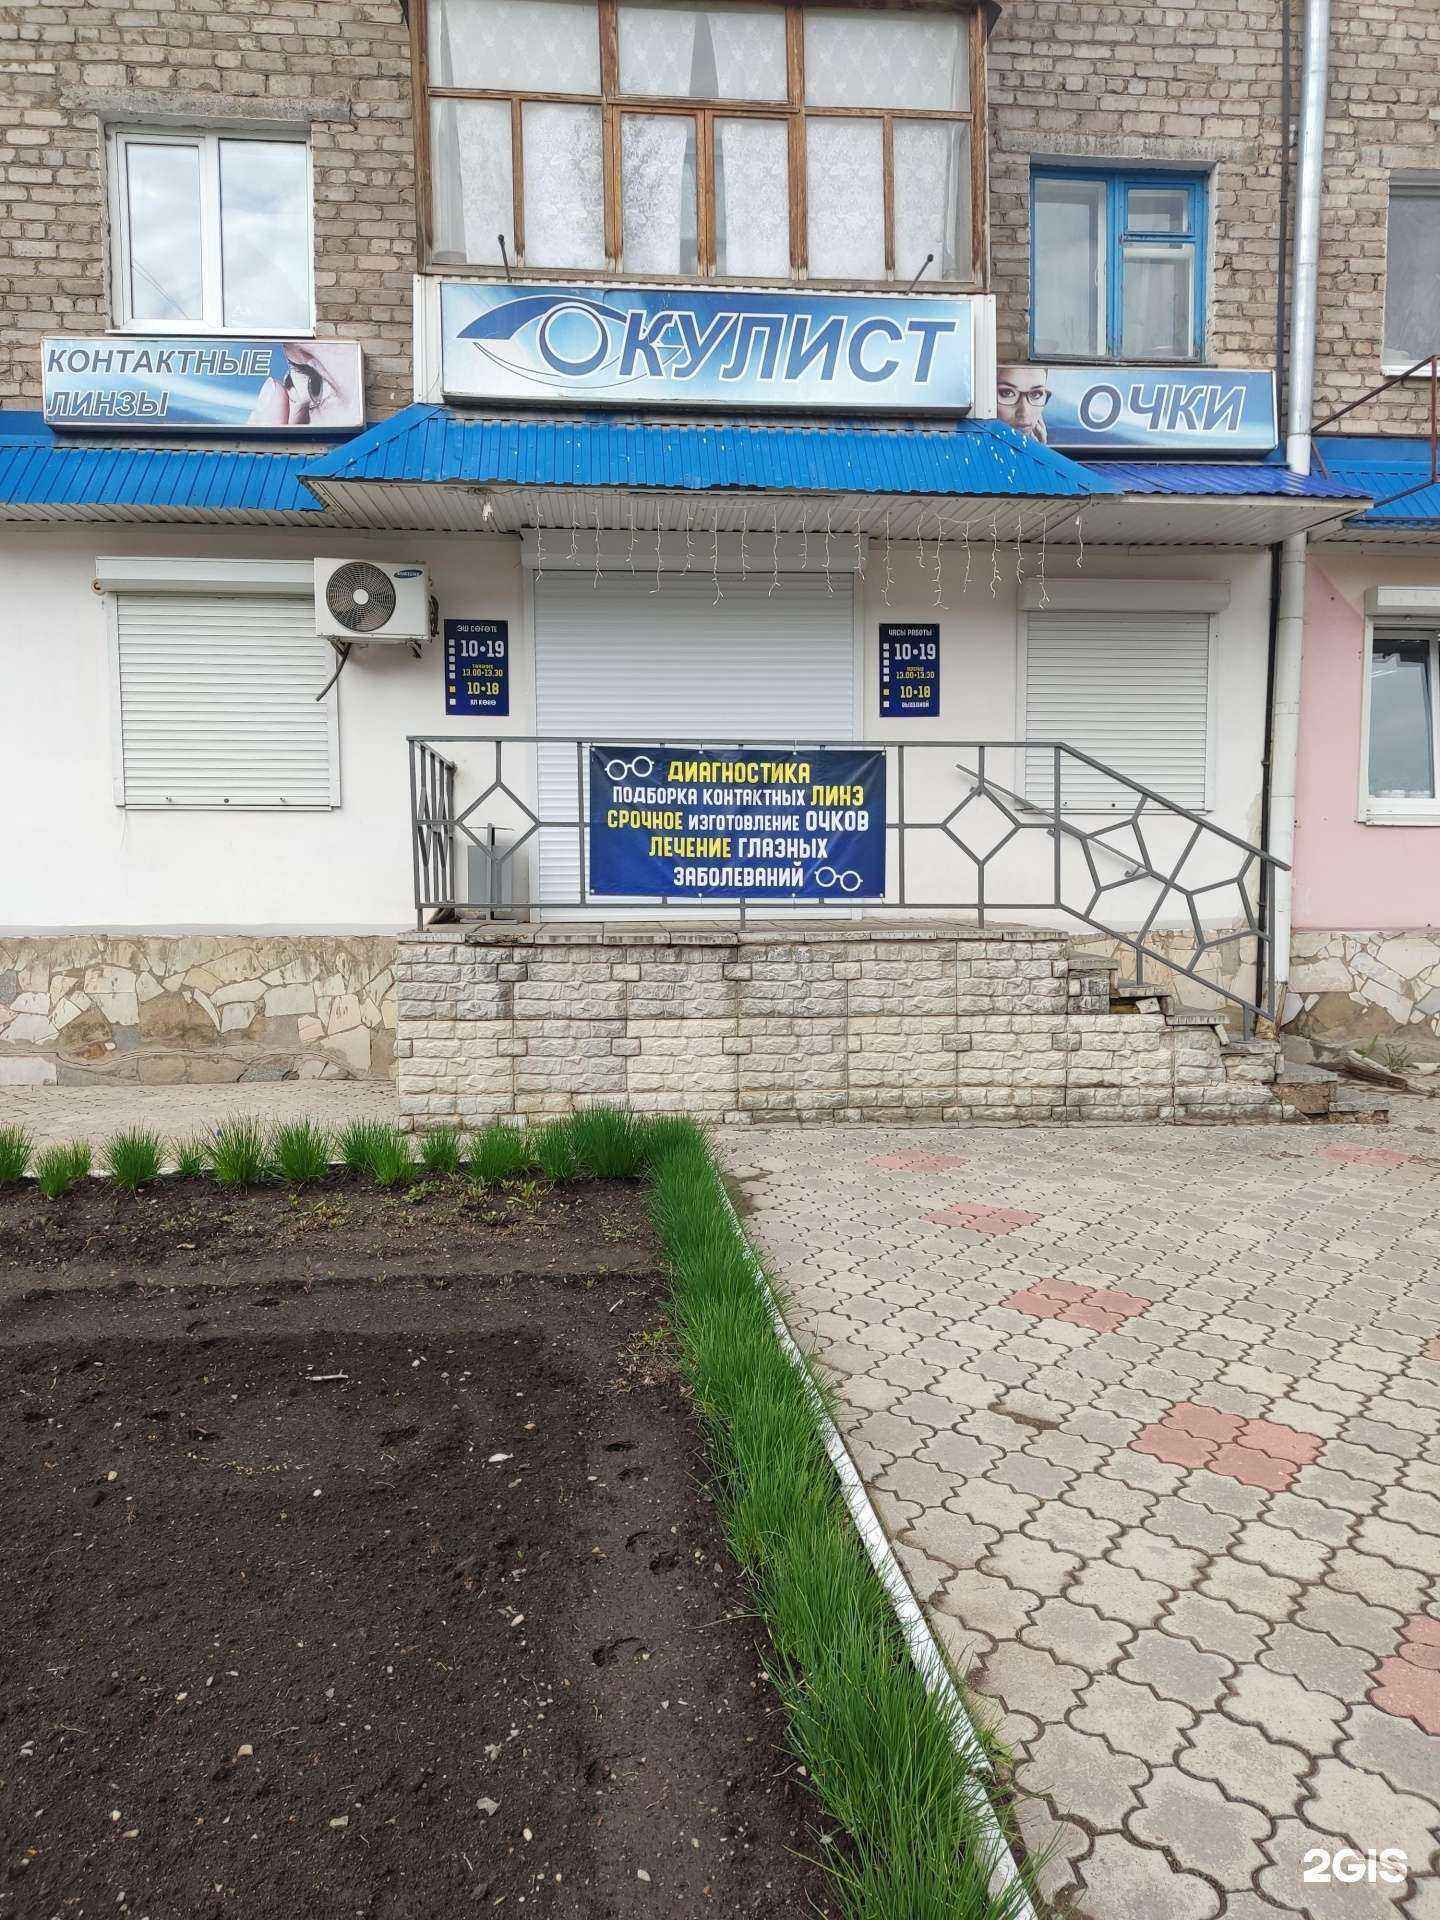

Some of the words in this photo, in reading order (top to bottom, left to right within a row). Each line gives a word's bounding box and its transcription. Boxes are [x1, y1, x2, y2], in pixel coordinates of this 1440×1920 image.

[539, 301, 959, 384] ОКУЛИСТ
[47, 348, 272, 376] КОНТАКТНЫЕ
[47, 391, 169, 417] ЛИНЗЫ
[1078, 382, 1246, 432] ОЧКИ
[667, 761, 811, 784] ДИАГНОСТИКА
[613, 786, 697, 805] ПОДБОРКА
[703, 788, 806, 806] КОНТАКТНЫХ
[810, 785, 864, 807] ЛИНЗ
[607, 810, 684, 830] СРОЧНОЕ
[688, 814, 800, 831] ИЗГОТОВЛЕНИЕ
[805, 810, 869, 832] ОЧКОВ
[648, 836, 732, 858] ЛЕЧЕНИЕ
[738, 838, 828, 859] ГЛАЗНЫХ
[673, 861, 804, 887] ЗАБОЛЕВАНИЙ
